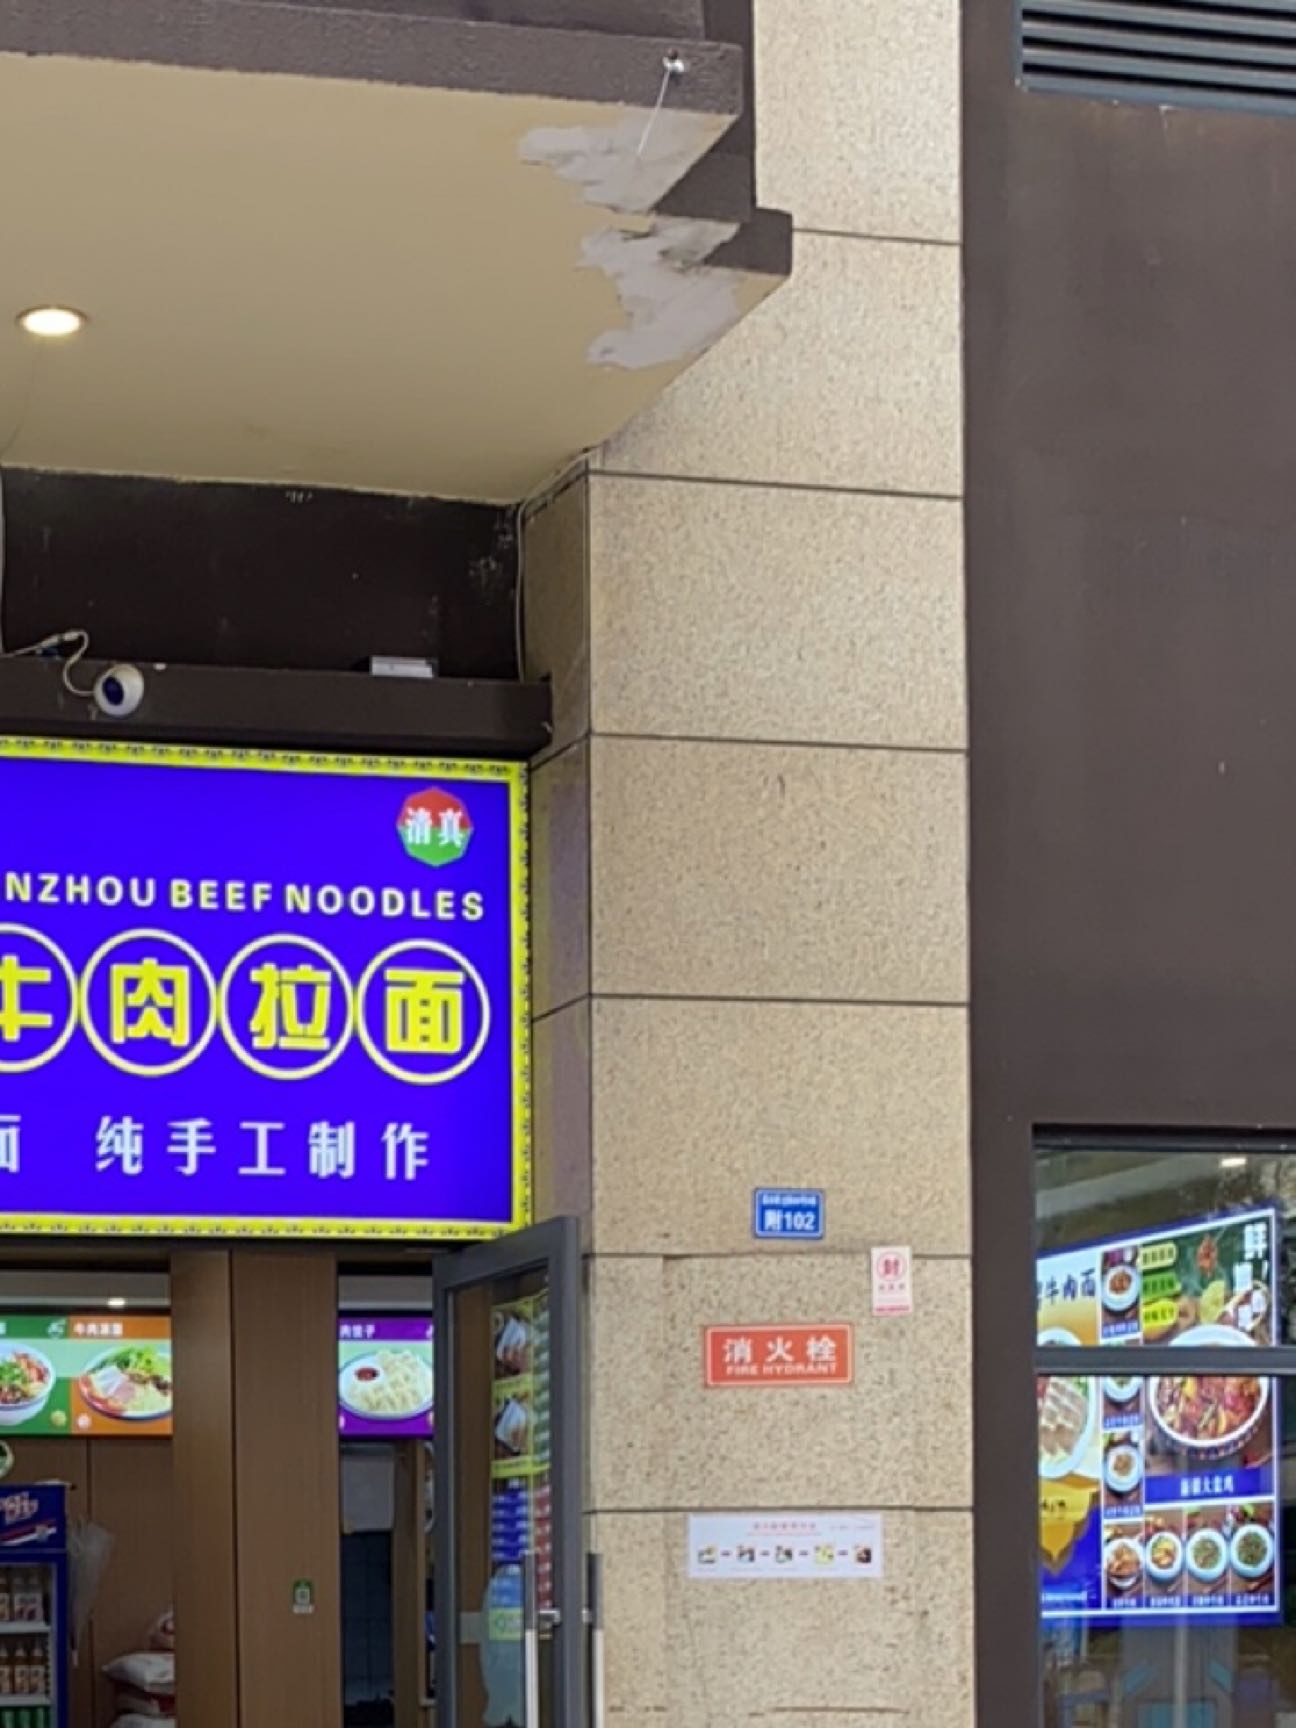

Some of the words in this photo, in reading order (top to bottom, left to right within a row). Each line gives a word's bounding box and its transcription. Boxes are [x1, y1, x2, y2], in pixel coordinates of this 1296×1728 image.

[405, 807, 464, 848] 清真
[169, 878, 273, 912] BEEF
[284, 884, 485, 922] NOODLES
[95, 1116, 429, 1181] 纯手工制作
[723, 1336, 836, 1363] 消火栓
[726, 1363, 759, 1376] FIRE
[763, 1362, 836, 1376] HYDRANT
